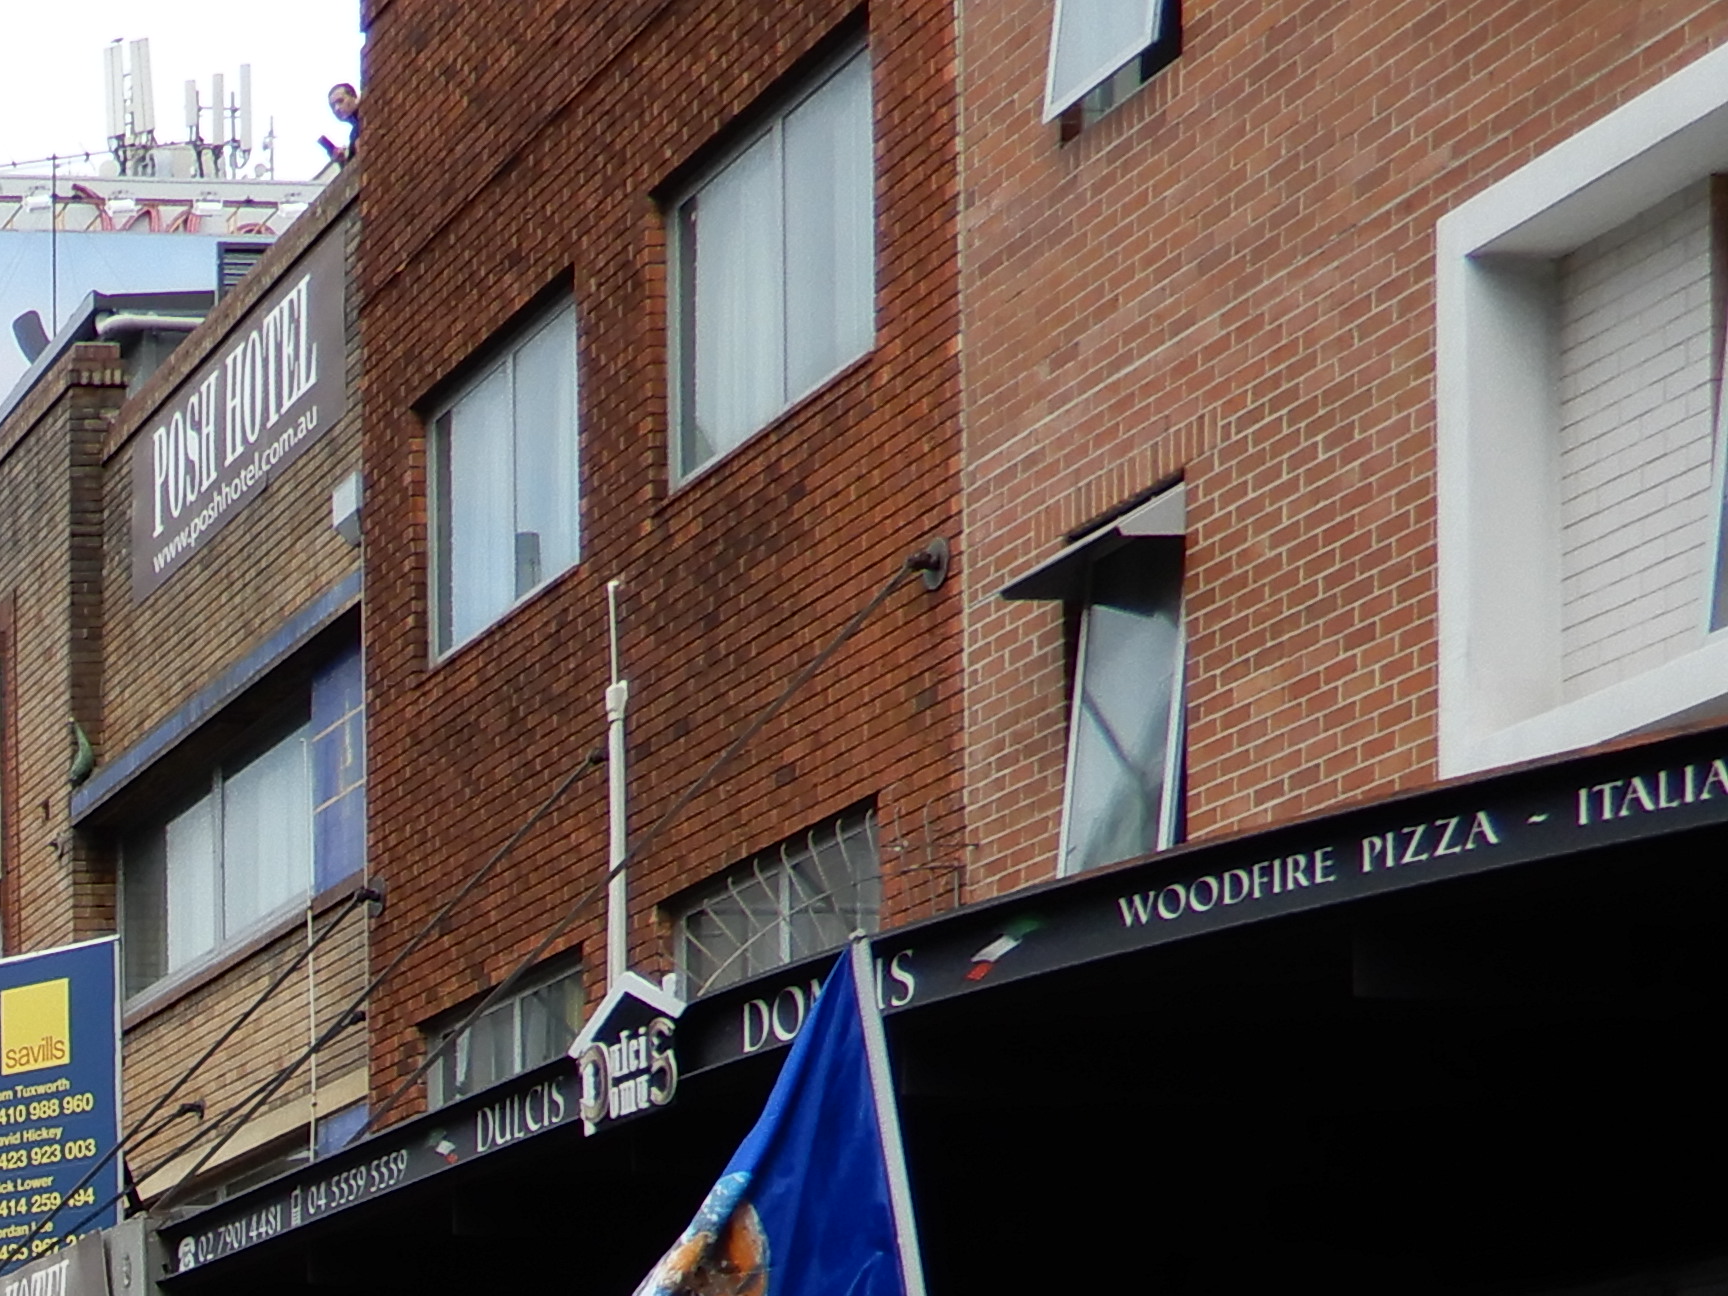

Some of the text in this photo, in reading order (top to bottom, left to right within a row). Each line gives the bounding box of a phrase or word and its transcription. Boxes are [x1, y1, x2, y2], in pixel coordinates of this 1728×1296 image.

[153, 274, 318, 538] POSH HOTEL
[152, 403, 319, 575] www.poshhotel.com.au
[1118, 845, 1337, 931] WOODFIRE
[1360, 810, 1500, 874] PIZZA
[4, 1036, 67, 1072] savills
[14, 1077, 71, 1100] Tuxworth
[29, 1098, 60, 1121] 988
[63, 1092, 94, 1115] 960
[476, 1076, 565, 1154] DULCIS
[22, 1125, 64, 1144] Hickey
[30, 1144, 62, 1166] 923
[64, 1138, 97, 1160] 003
[16, 1174, 55, 1192] Lower
[307, 1149, 408, 1215] 04 5559 5559
[31, 1191, 61, 1214] 259
[197, 1203, 282, 1263] 02 7901 4481
